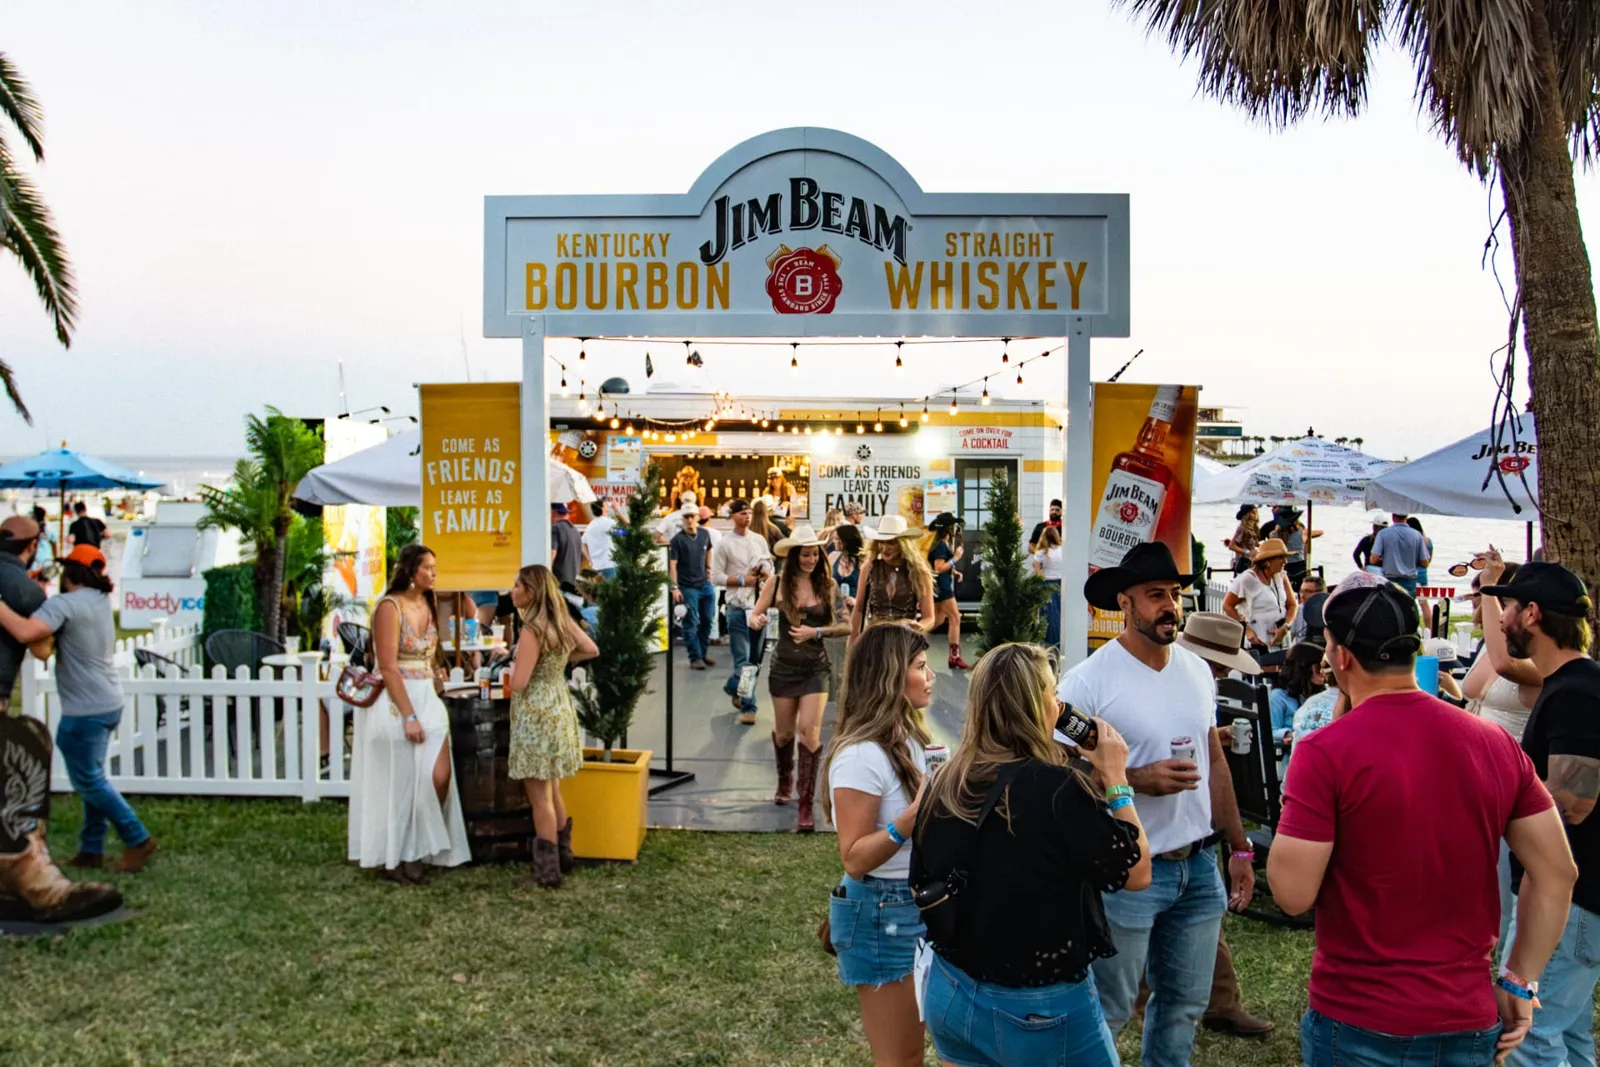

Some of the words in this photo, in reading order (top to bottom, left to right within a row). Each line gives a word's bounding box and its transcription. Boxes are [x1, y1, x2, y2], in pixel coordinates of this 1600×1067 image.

[699, 192, 783, 266] JIM
[789, 177, 909, 267] BEAM
[557, 233, 671, 258] KENTUCKY
[945, 232, 1055, 257] STRAIGHT
[525, 261, 730, 310] BOURBON
[795, 275, 813, 296] B
[884, 261, 1088, 310] WHISKEY
[442, 438, 475, 453] COME
[484, 438, 500, 453] AS
[962, 438, 968, 449] A
[971, 437, 1009, 449] COCKTAIL
[1512, 441, 1537, 455] BE
[426, 457, 517, 486] FRIENDS
[819, 465, 850, 479] COME
[855, 465, 870, 479] AS
[874, 465, 920, 479] FRIENDS
[440, 490, 477, 505] LEAVE
[486, 489, 502, 504] AS
[843, 480, 873, 493] LEAVE
[876, 480, 890, 493] AS
[1106, 483, 1130, 501] JIM
[1130, 484, 1159, 516] BEAM
[433, 507, 511, 535] FAMILY
[1088, 619, 1126, 634] OURBO
